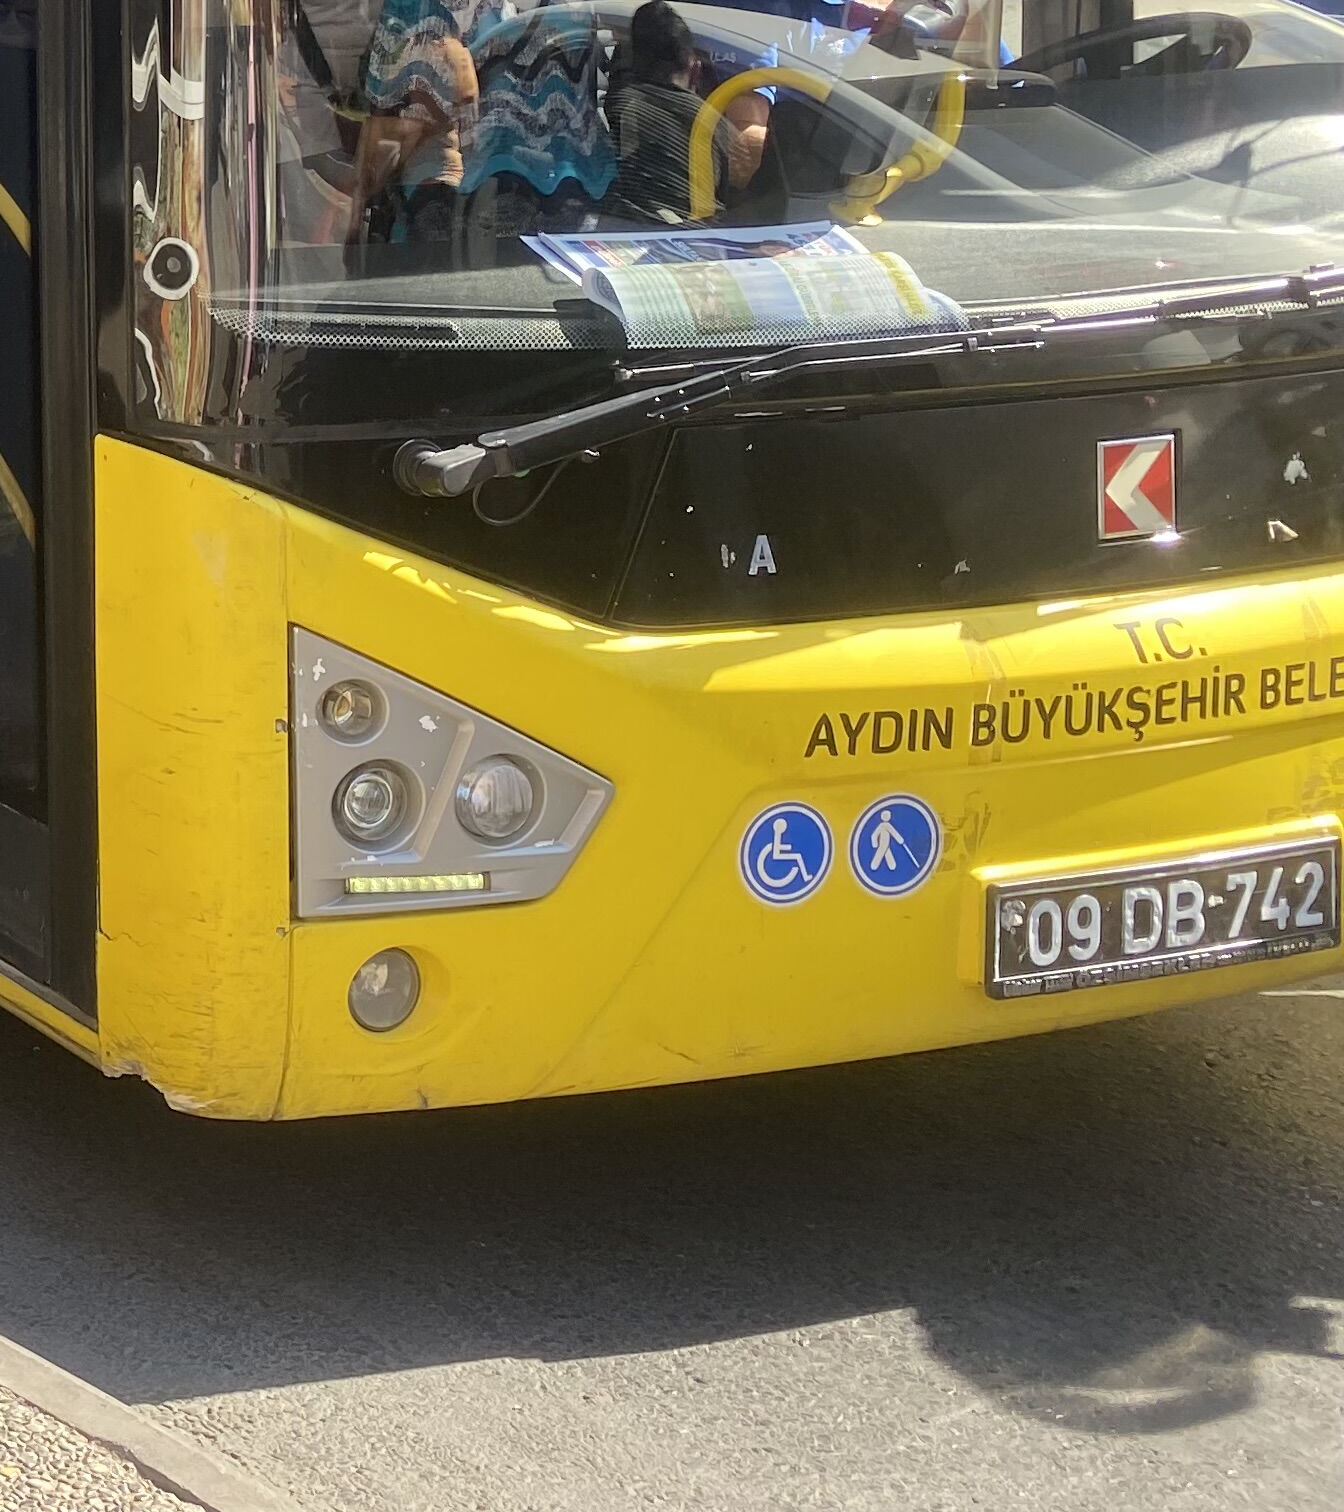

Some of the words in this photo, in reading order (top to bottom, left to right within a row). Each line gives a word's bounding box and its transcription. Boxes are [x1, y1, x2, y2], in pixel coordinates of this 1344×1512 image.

[748, 534, 777, 575] A
[1113, 617, 1208, 664] T.C.
[803, 706, 954, 758] AYDIN
[970, 665, 1247, 746] BÜYÜKŞEHİR
[1027, 894, 1103, 967] 09
[1121, 879, 1205, 955] DB
[1226, 861, 1325, 938] 742
